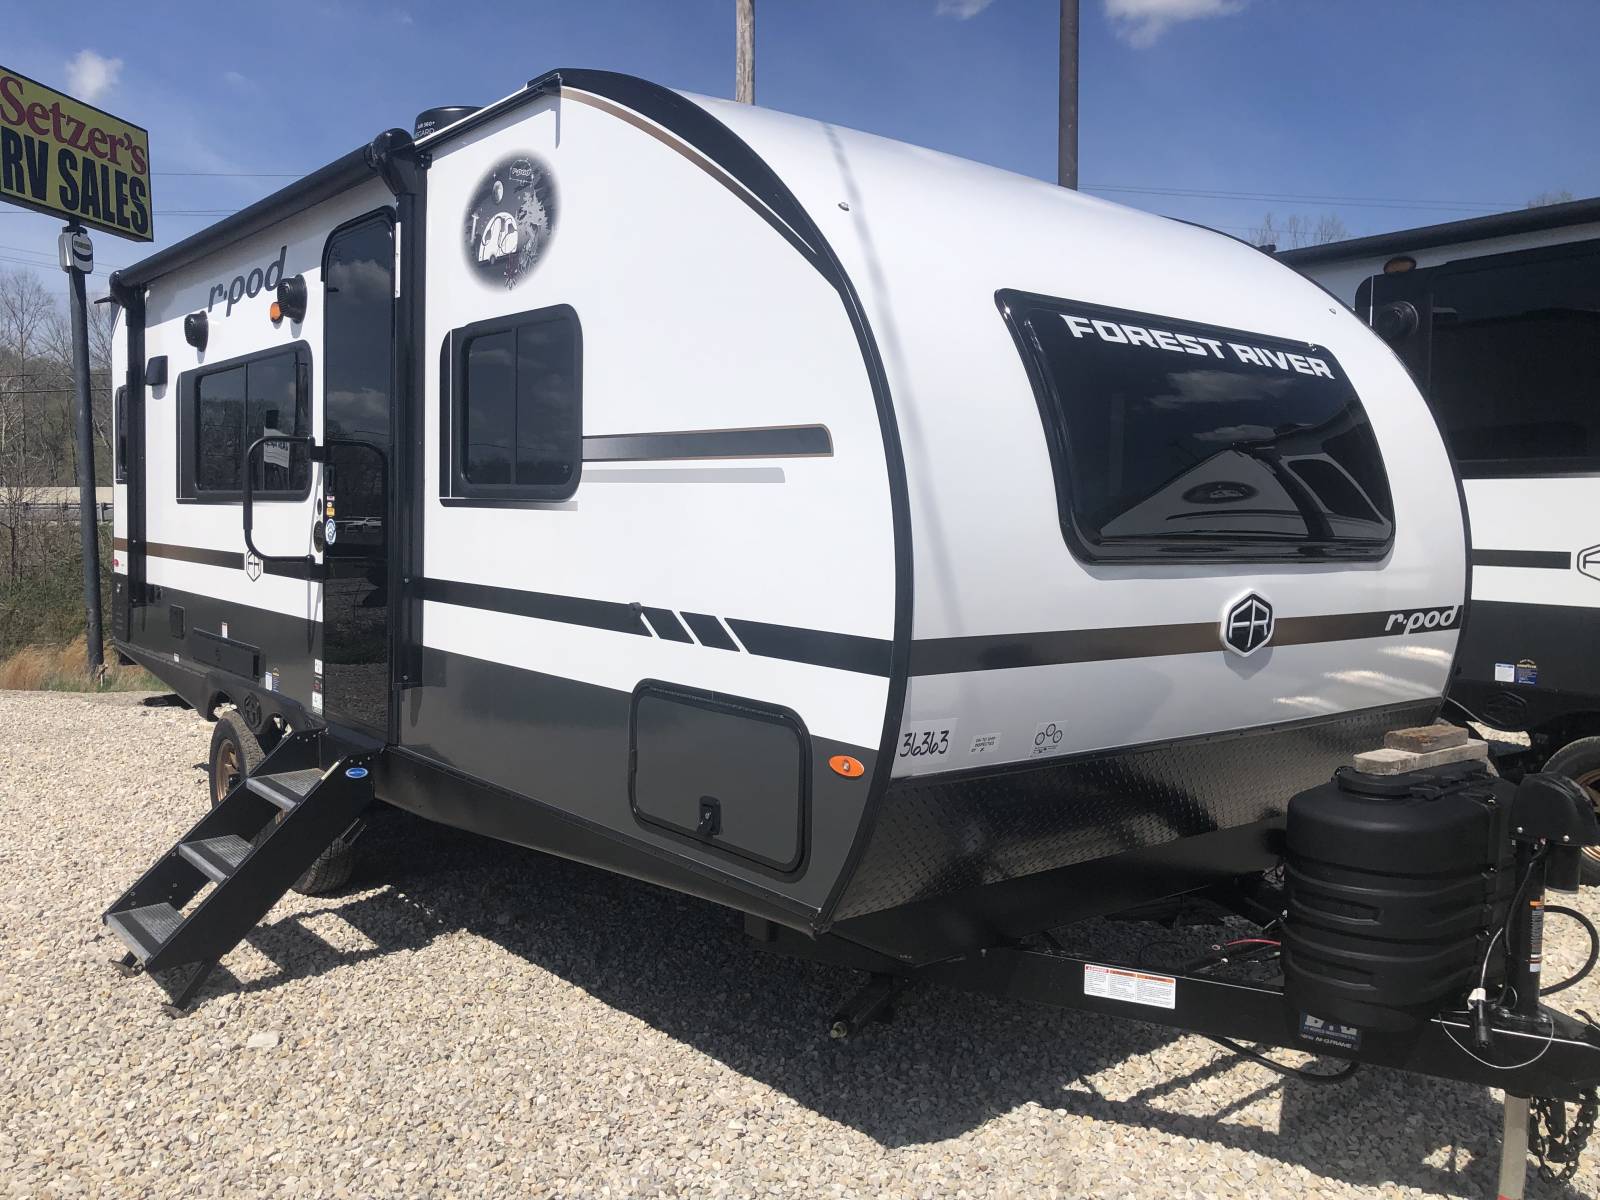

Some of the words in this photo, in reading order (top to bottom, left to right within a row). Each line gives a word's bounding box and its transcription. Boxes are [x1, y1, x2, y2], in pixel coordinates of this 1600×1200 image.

[0, 76, 147, 175] Setzer's
[1, 126, 49, 201] RV
[58, 148, 149, 235] SALES
[1059, 313, 1225, 359] FOREST
[1226, 342, 1336, 380] RIVER
[900, 730, 949, 757] 36363
